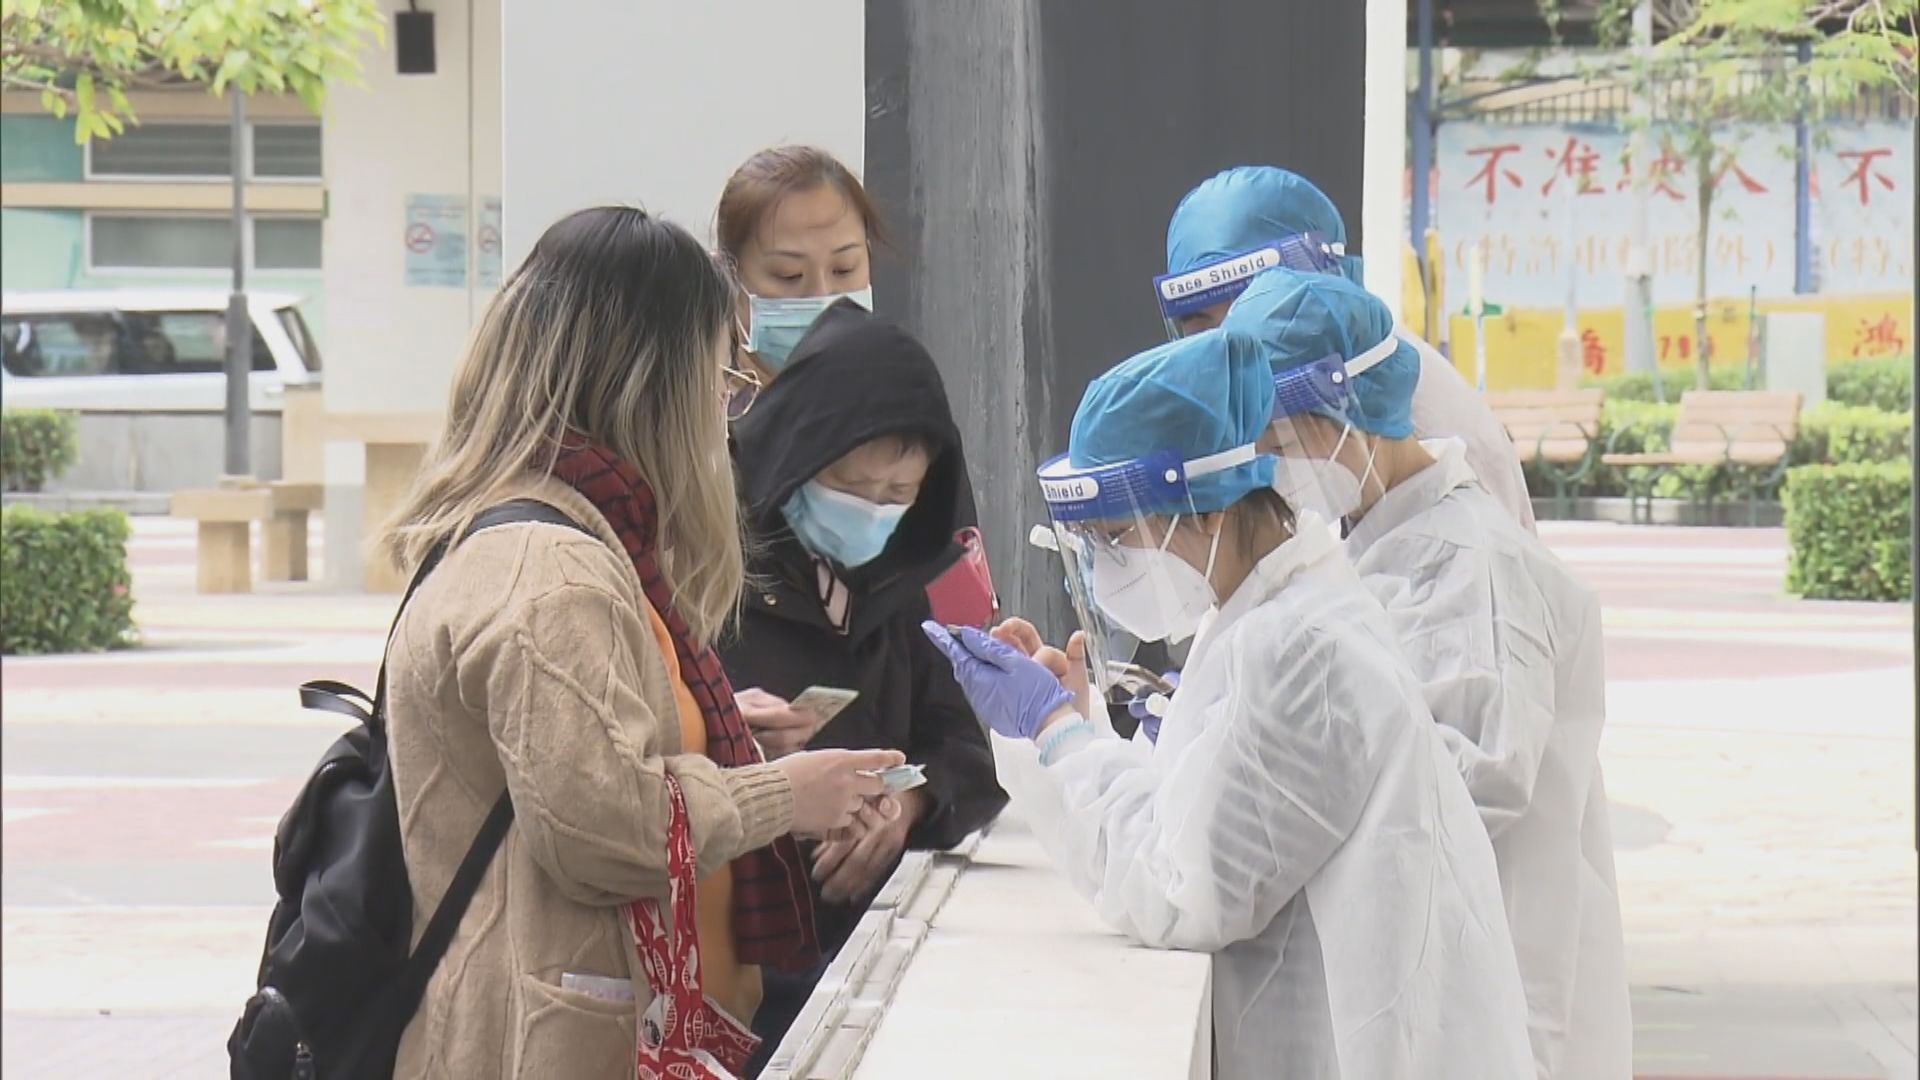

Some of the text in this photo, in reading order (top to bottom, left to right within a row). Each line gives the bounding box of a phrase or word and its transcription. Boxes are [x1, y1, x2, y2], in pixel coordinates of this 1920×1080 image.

[1837, 146, 1895, 205] 不
[1168, 256, 1266, 297] Face Shield
